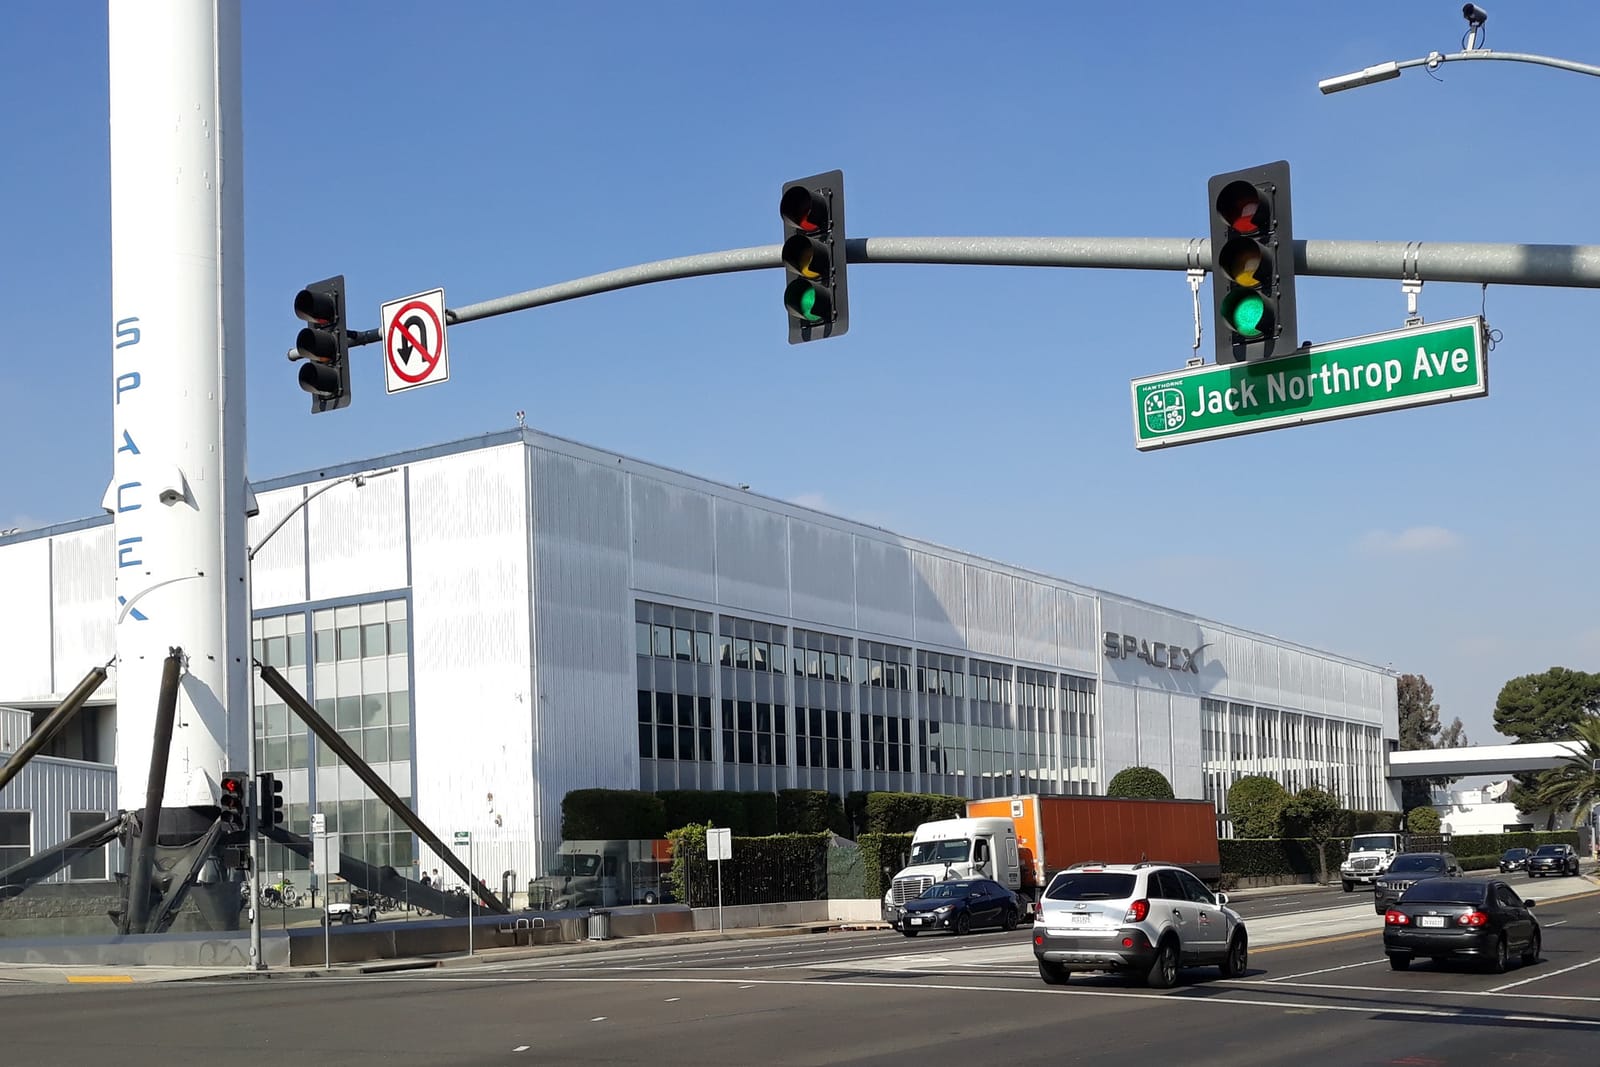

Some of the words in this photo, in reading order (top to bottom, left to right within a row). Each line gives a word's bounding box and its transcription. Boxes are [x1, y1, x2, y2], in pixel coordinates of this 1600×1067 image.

[1142, 380, 1184, 392] HAWTHORNE
[1191, 378, 1258, 417] Jack
[1267, 359, 1402, 404] Northrop
[1413, 347, 1469, 380] Ave
[1103, 631, 1214, 674] SPACEX
